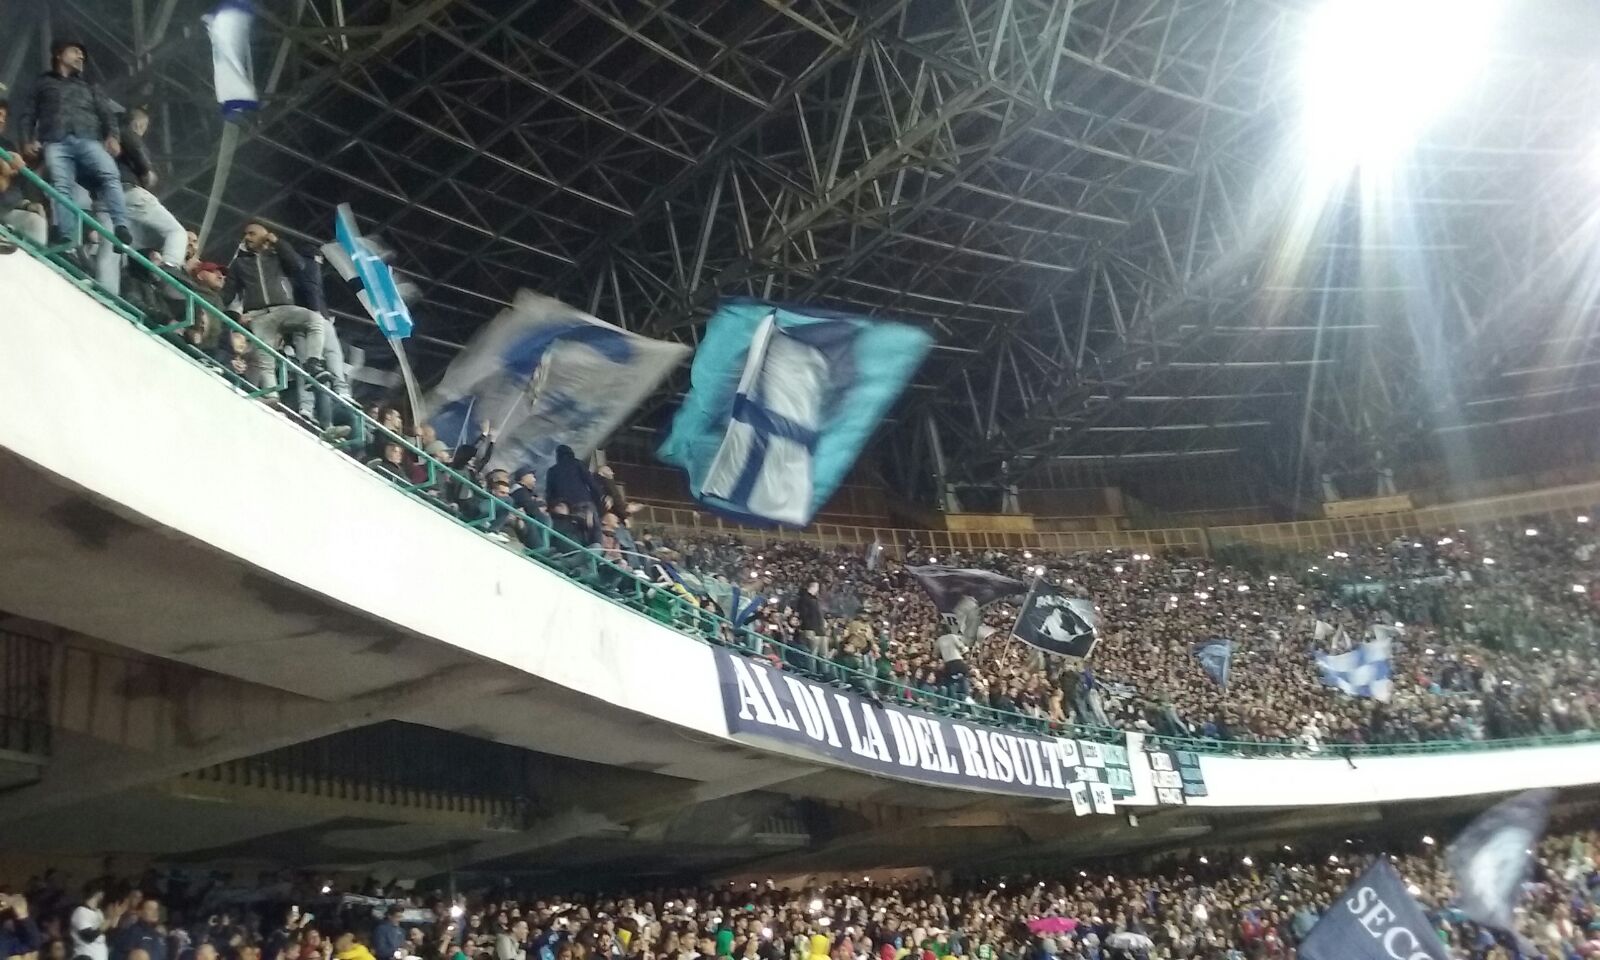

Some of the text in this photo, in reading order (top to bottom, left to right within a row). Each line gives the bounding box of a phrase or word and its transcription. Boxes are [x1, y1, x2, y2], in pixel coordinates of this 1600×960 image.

[729, 655, 800, 731] AL
[783, 675, 842, 748] DI
[834, 694, 893, 762] LA
[885, 709, 960, 774] DEL
[952, 724, 1072, 790] RISULT
